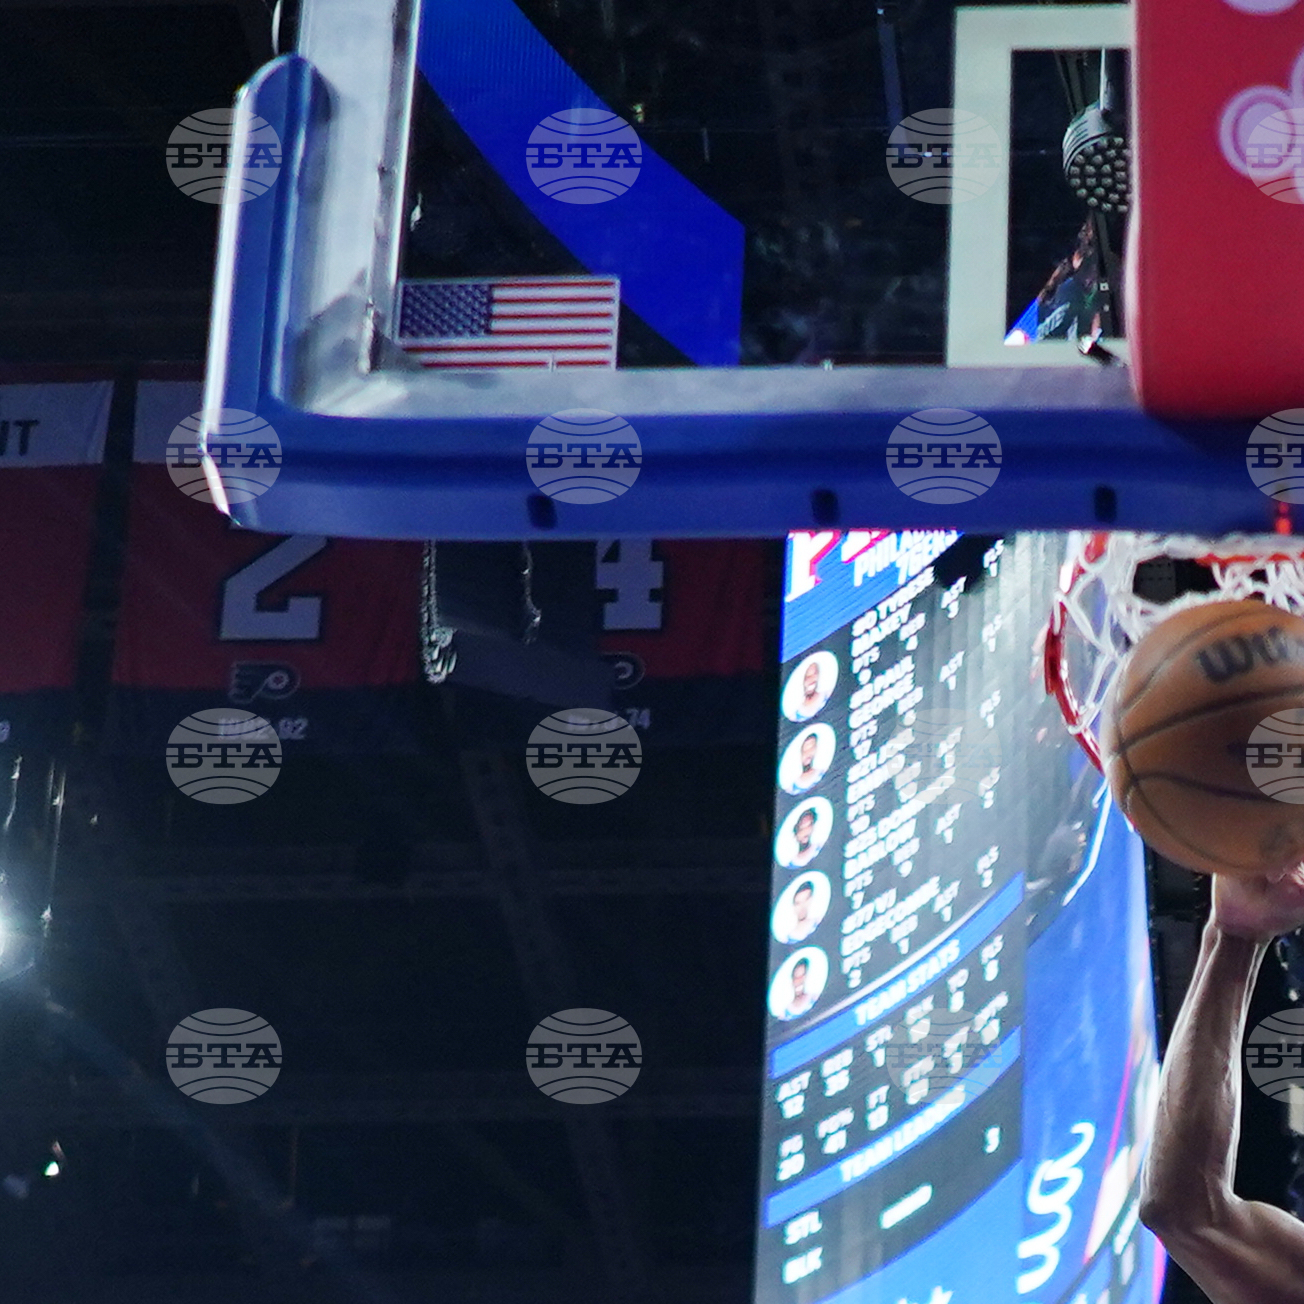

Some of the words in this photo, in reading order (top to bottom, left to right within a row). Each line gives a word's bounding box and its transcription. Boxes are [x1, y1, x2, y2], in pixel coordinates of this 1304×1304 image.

[906, 938, 960, 994] STATS
[784, 1209, 823, 1245] STL
[782, 1246, 823, 1284] BLK
